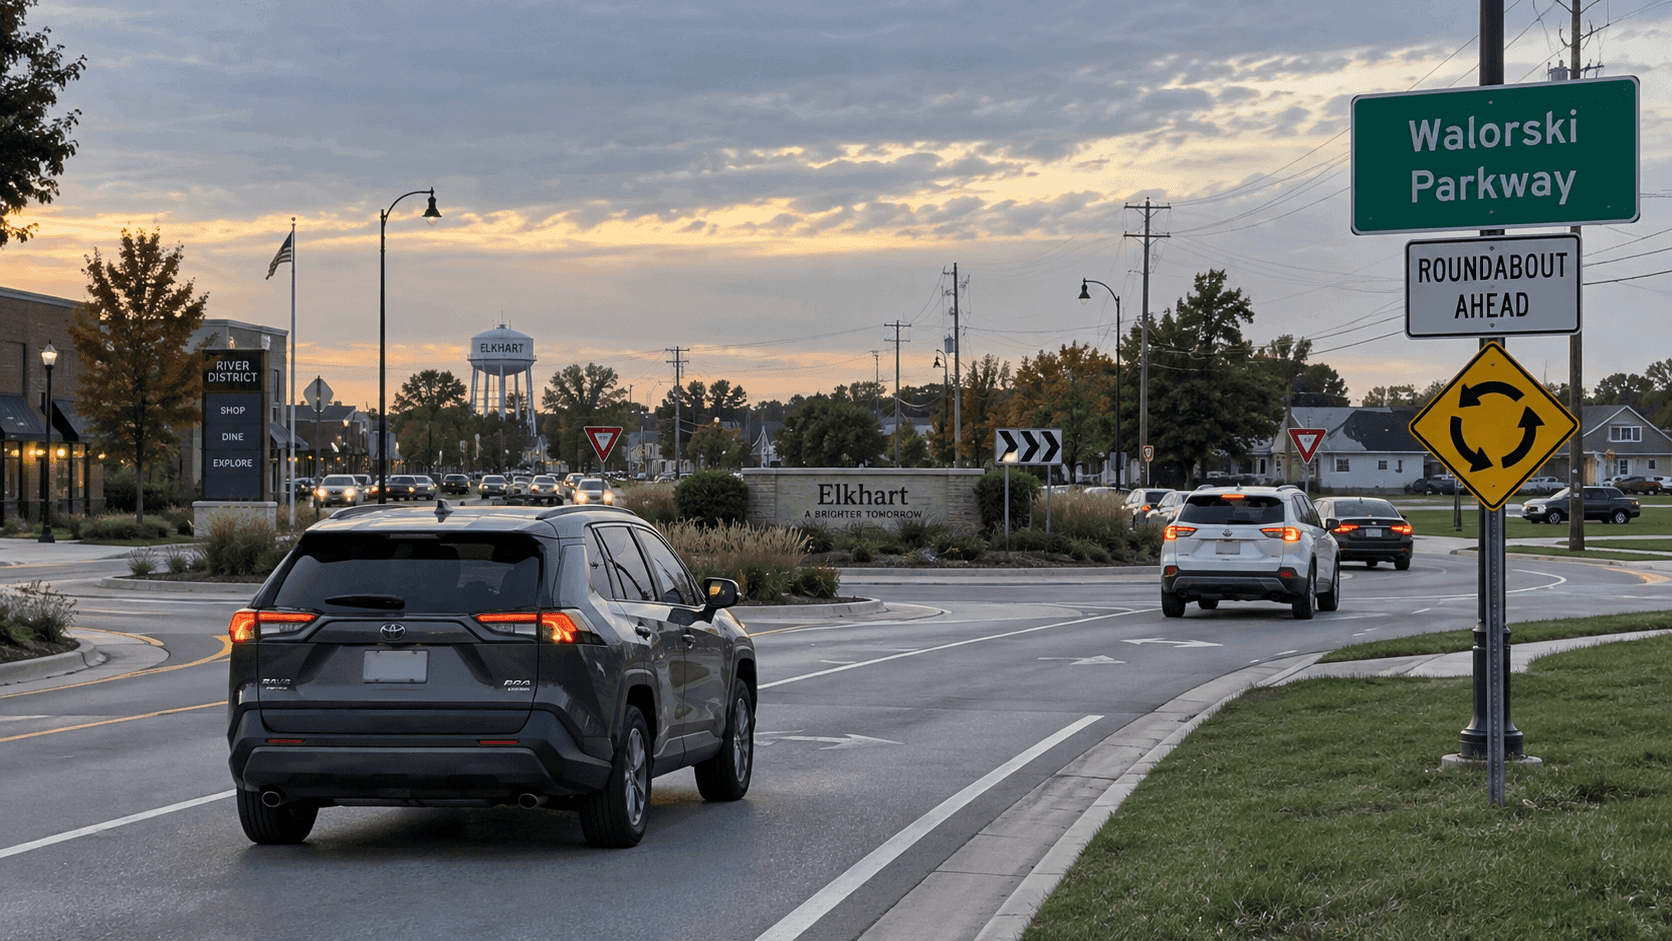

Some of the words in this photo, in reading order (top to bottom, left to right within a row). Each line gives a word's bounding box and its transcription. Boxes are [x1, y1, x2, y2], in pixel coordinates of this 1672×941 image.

[1408, 108, 1578, 153] Walorski
[1410, 165, 1577, 206] Parkway
[1418, 252, 1568, 284] ROUNDABOUT
[1454, 291, 1529, 319] AHEAD
[480, 343, 524, 353] ELKHART
[216, 360, 250, 371] RIVER
[208, 372, 258, 382] DISTRICT
[220, 406, 246, 415] SHOP
[222, 432, 244, 441] DINE
[213, 458, 253, 468] EXPLORE
[817, 483, 909, 506] Elkhart
[804, 510, 811, 519] A
[815, 510, 862, 519] BRIGHTER
[866, 510, 923, 519] TOMORROW
